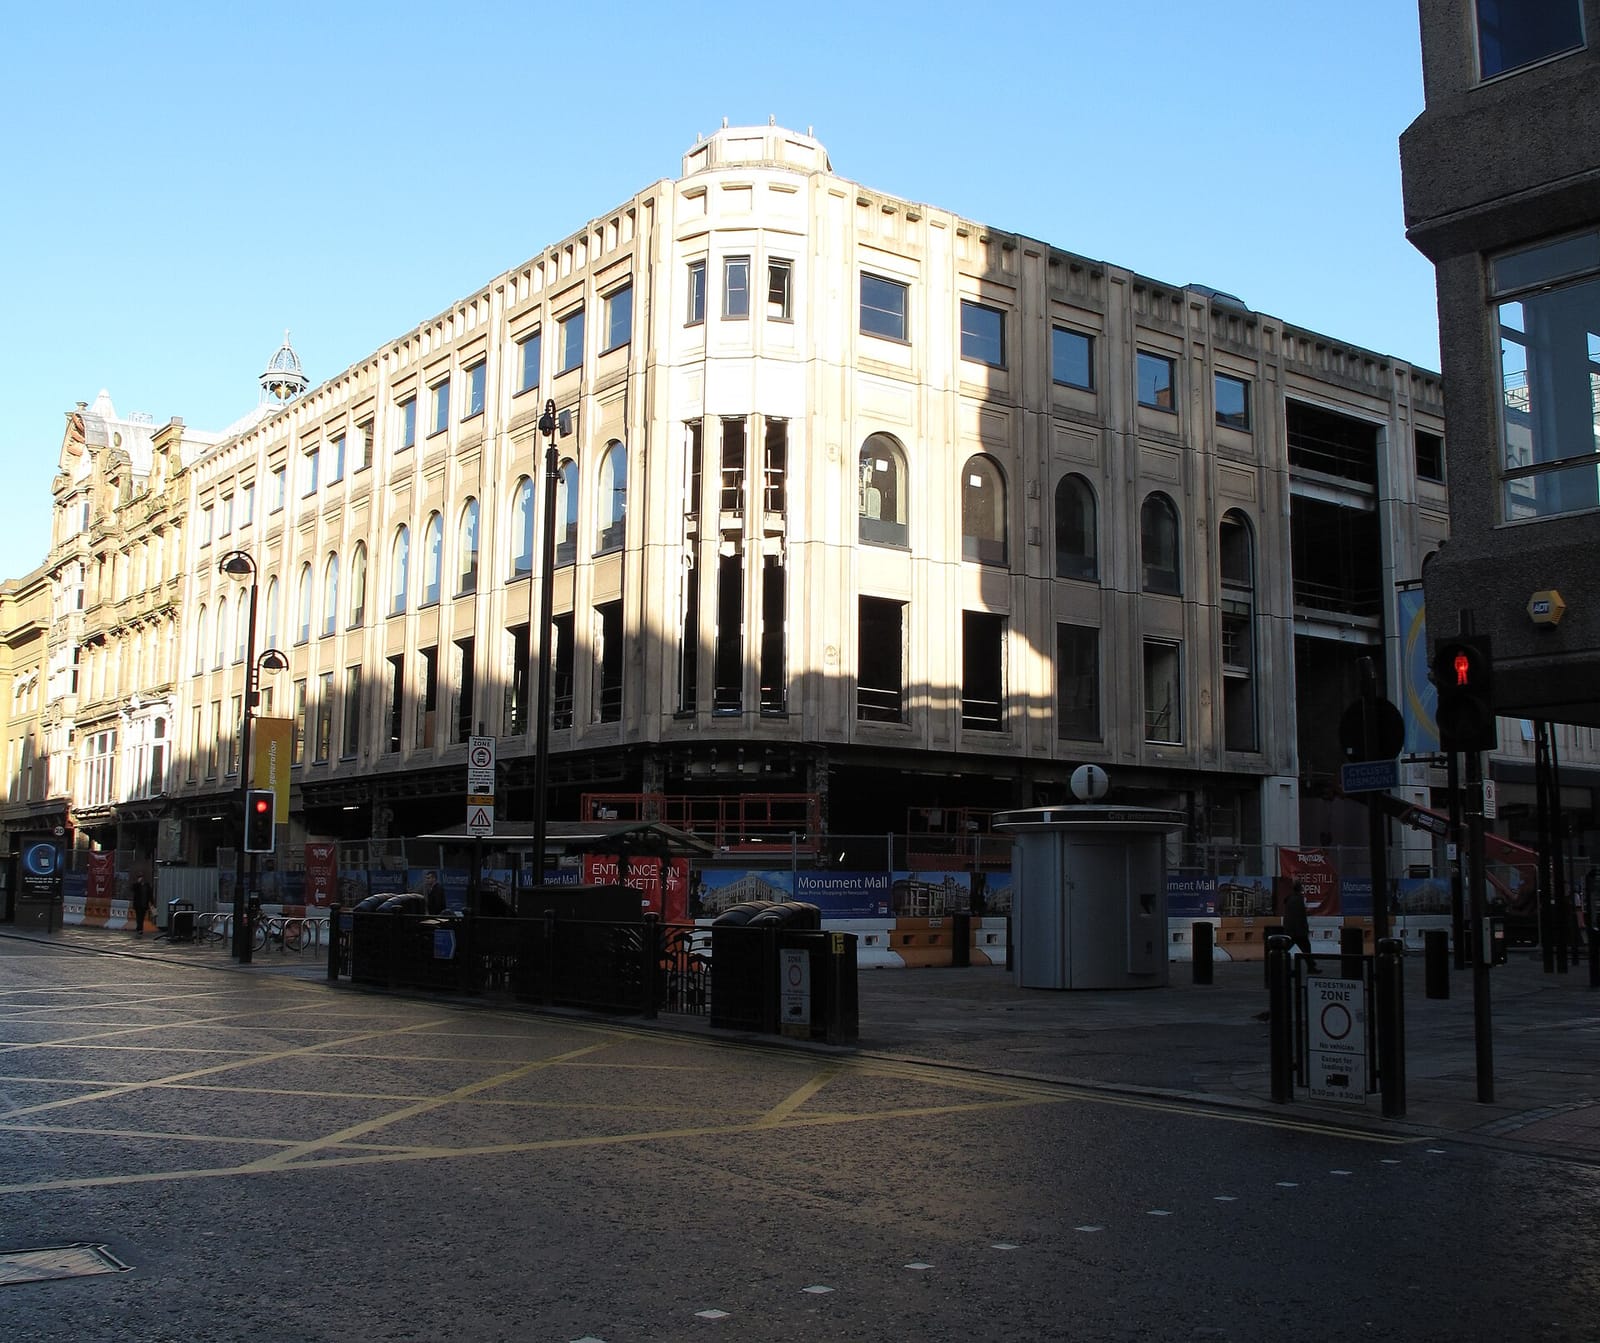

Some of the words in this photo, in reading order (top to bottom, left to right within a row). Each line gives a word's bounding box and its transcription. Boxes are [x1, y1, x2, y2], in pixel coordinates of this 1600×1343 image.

[268, 740, 277, 785] generation
[592, 863, 658, 876] ENTANCE
[798, 877, 861, 889] Monument
[864, 876, 888, 889] Mall
[1195, 880, 1215, 891] Mall
[1314, 981, 1357, 990] PEDESTRIAN
[1320, 990, 1350, 1001] ZONE
